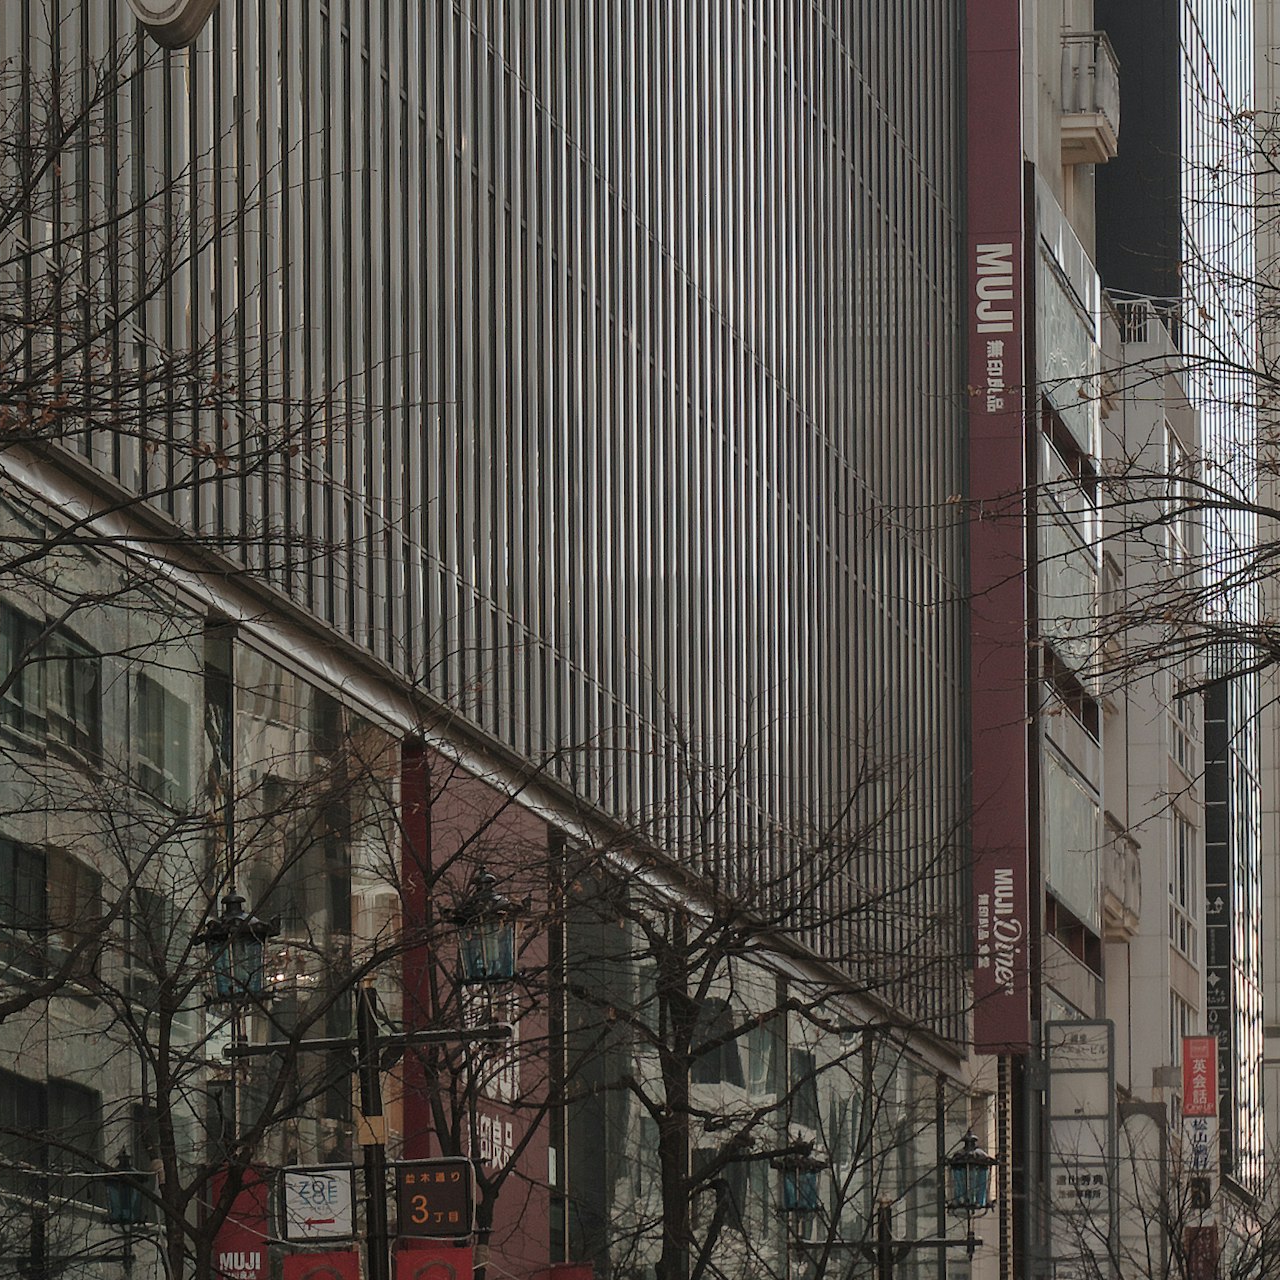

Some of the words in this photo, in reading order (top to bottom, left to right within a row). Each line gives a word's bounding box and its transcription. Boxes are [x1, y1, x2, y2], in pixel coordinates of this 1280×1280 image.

[976, 243, 1014, 334] MUJI
[986, 339, 1005, 413] 無印良品
[993, 868, 1014, 915] MUJI
[1192, 1058, 1208, 1105] 英会話
[410, 1194, 460, 1224] 3丁目
[219, 1251, 261, 1270] MUJI
